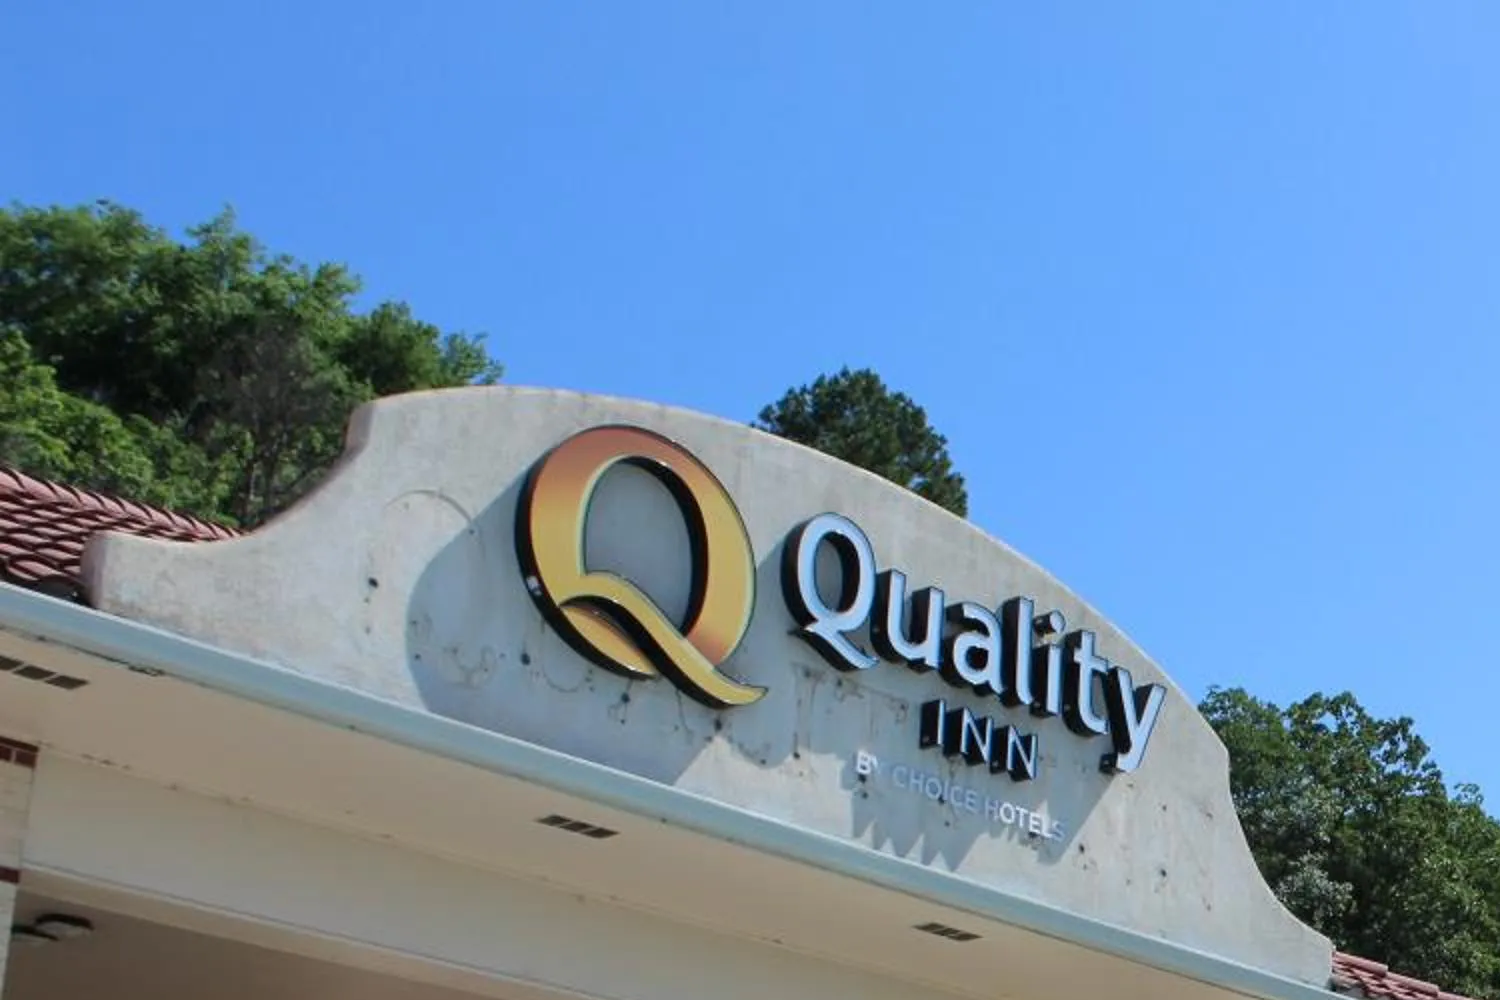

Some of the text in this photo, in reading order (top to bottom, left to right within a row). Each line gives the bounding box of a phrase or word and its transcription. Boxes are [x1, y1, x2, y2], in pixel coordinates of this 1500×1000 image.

[515, 424, 768, 708] Q
[781, 511, 1167, 774] Quality
[892, 766, 979, 813] CHOICE
[984, 798, 1066, 842] HOTELS
[920, 700, 1039, 782] INN
